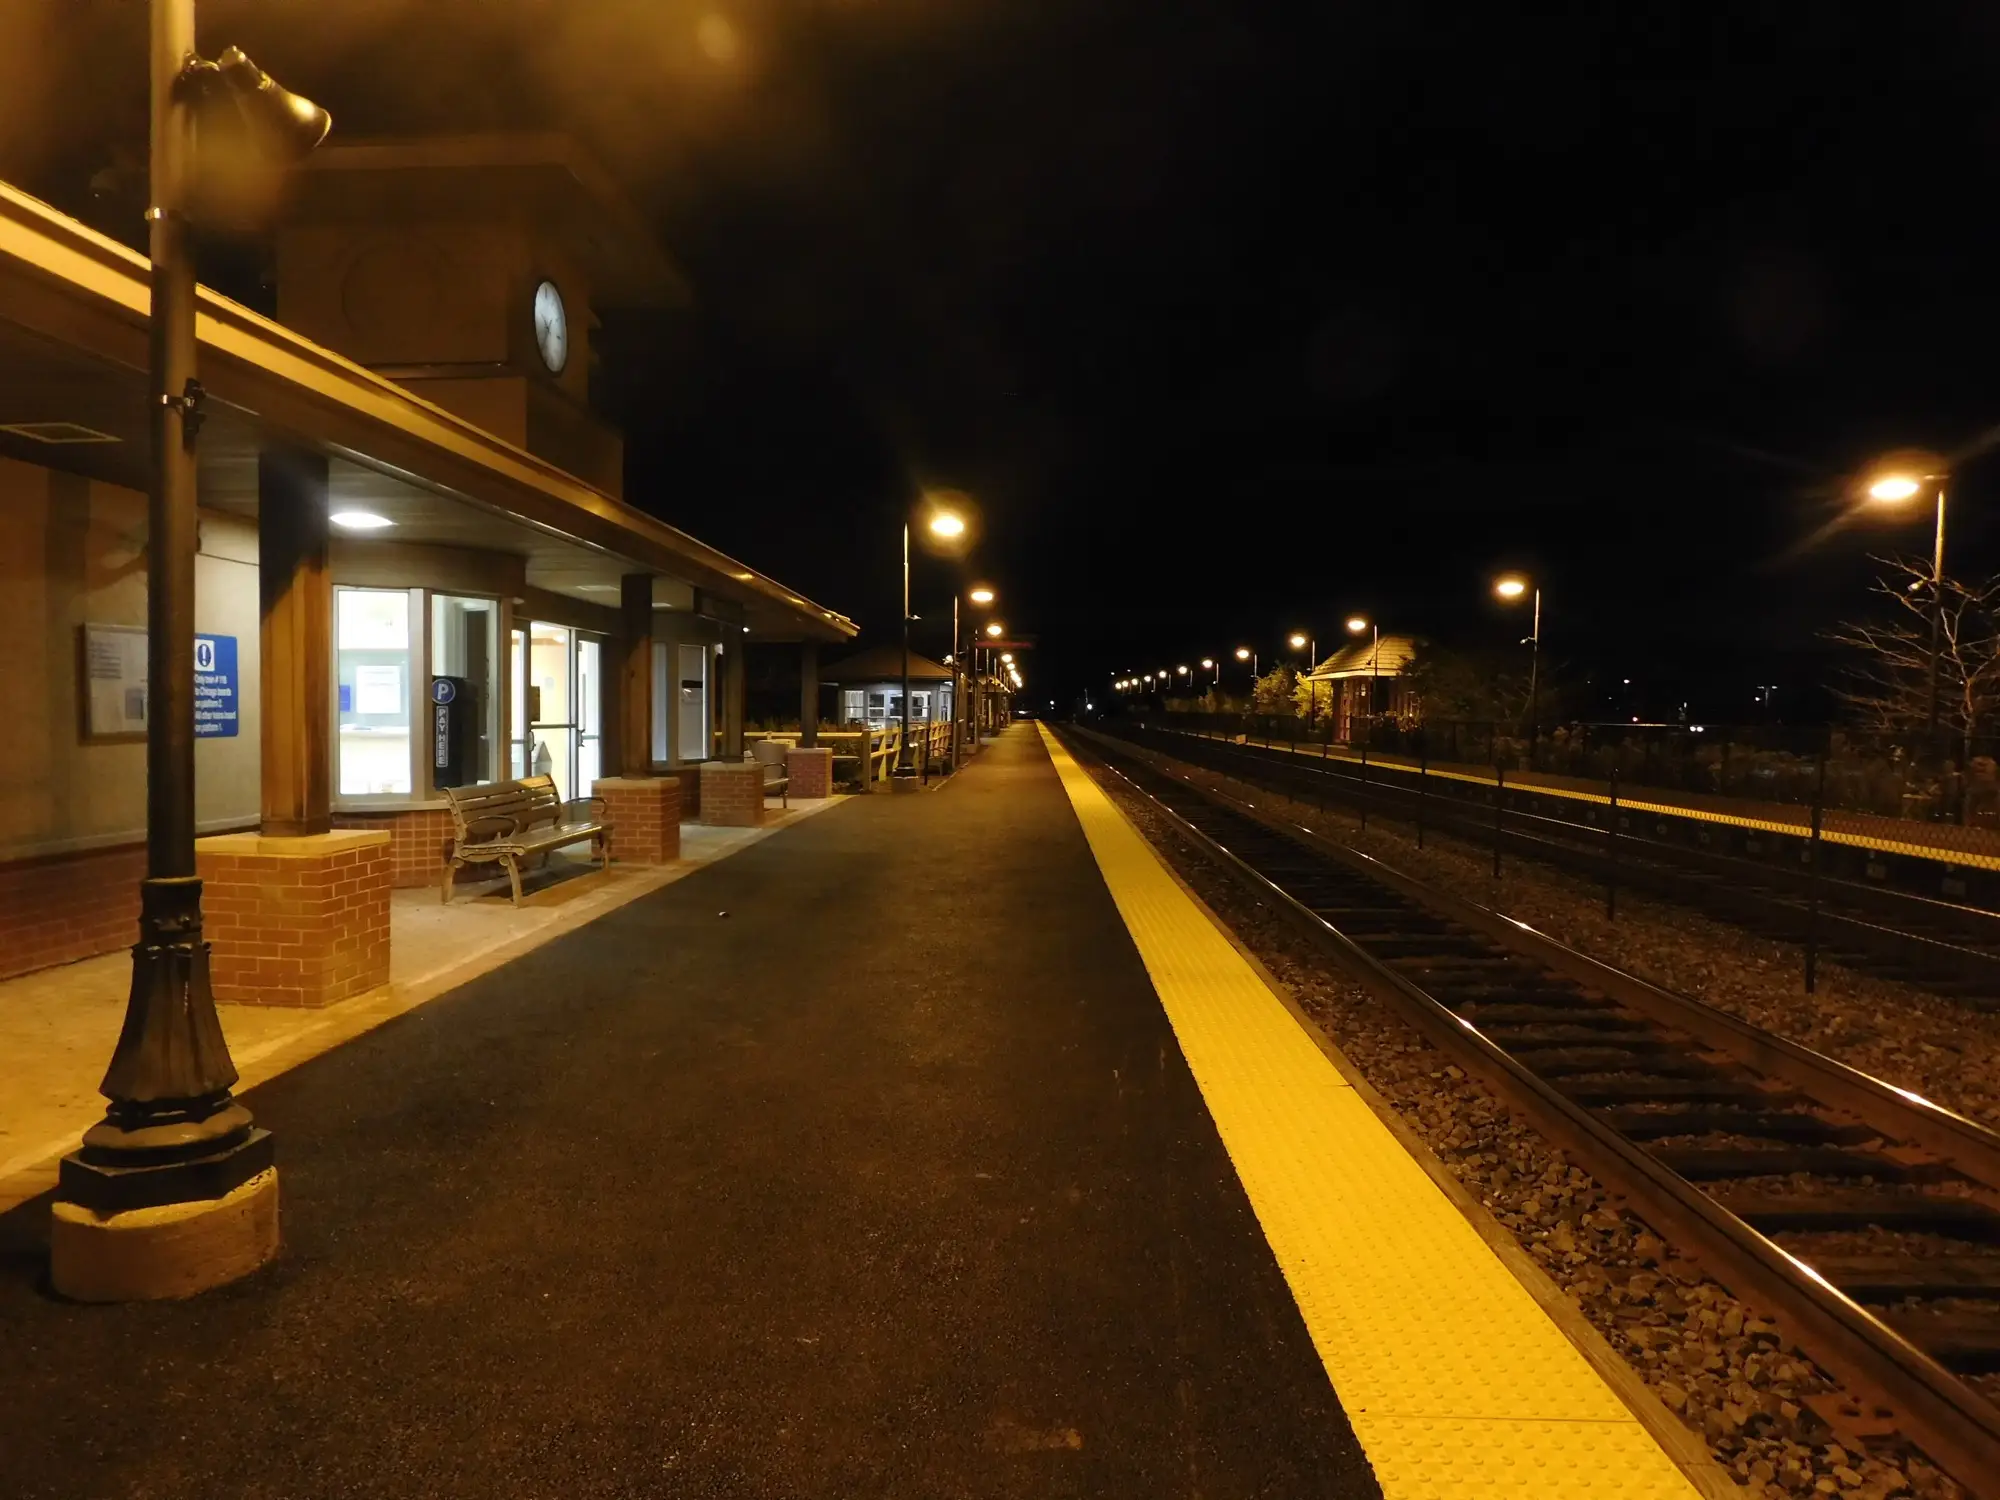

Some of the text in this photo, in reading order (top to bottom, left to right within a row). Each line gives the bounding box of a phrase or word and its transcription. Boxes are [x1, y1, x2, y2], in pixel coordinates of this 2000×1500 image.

[200, 686, 217, 698] Chicago
[437, 683, 449, 700] P
[438, 709, 446, 764] PAY HERE
